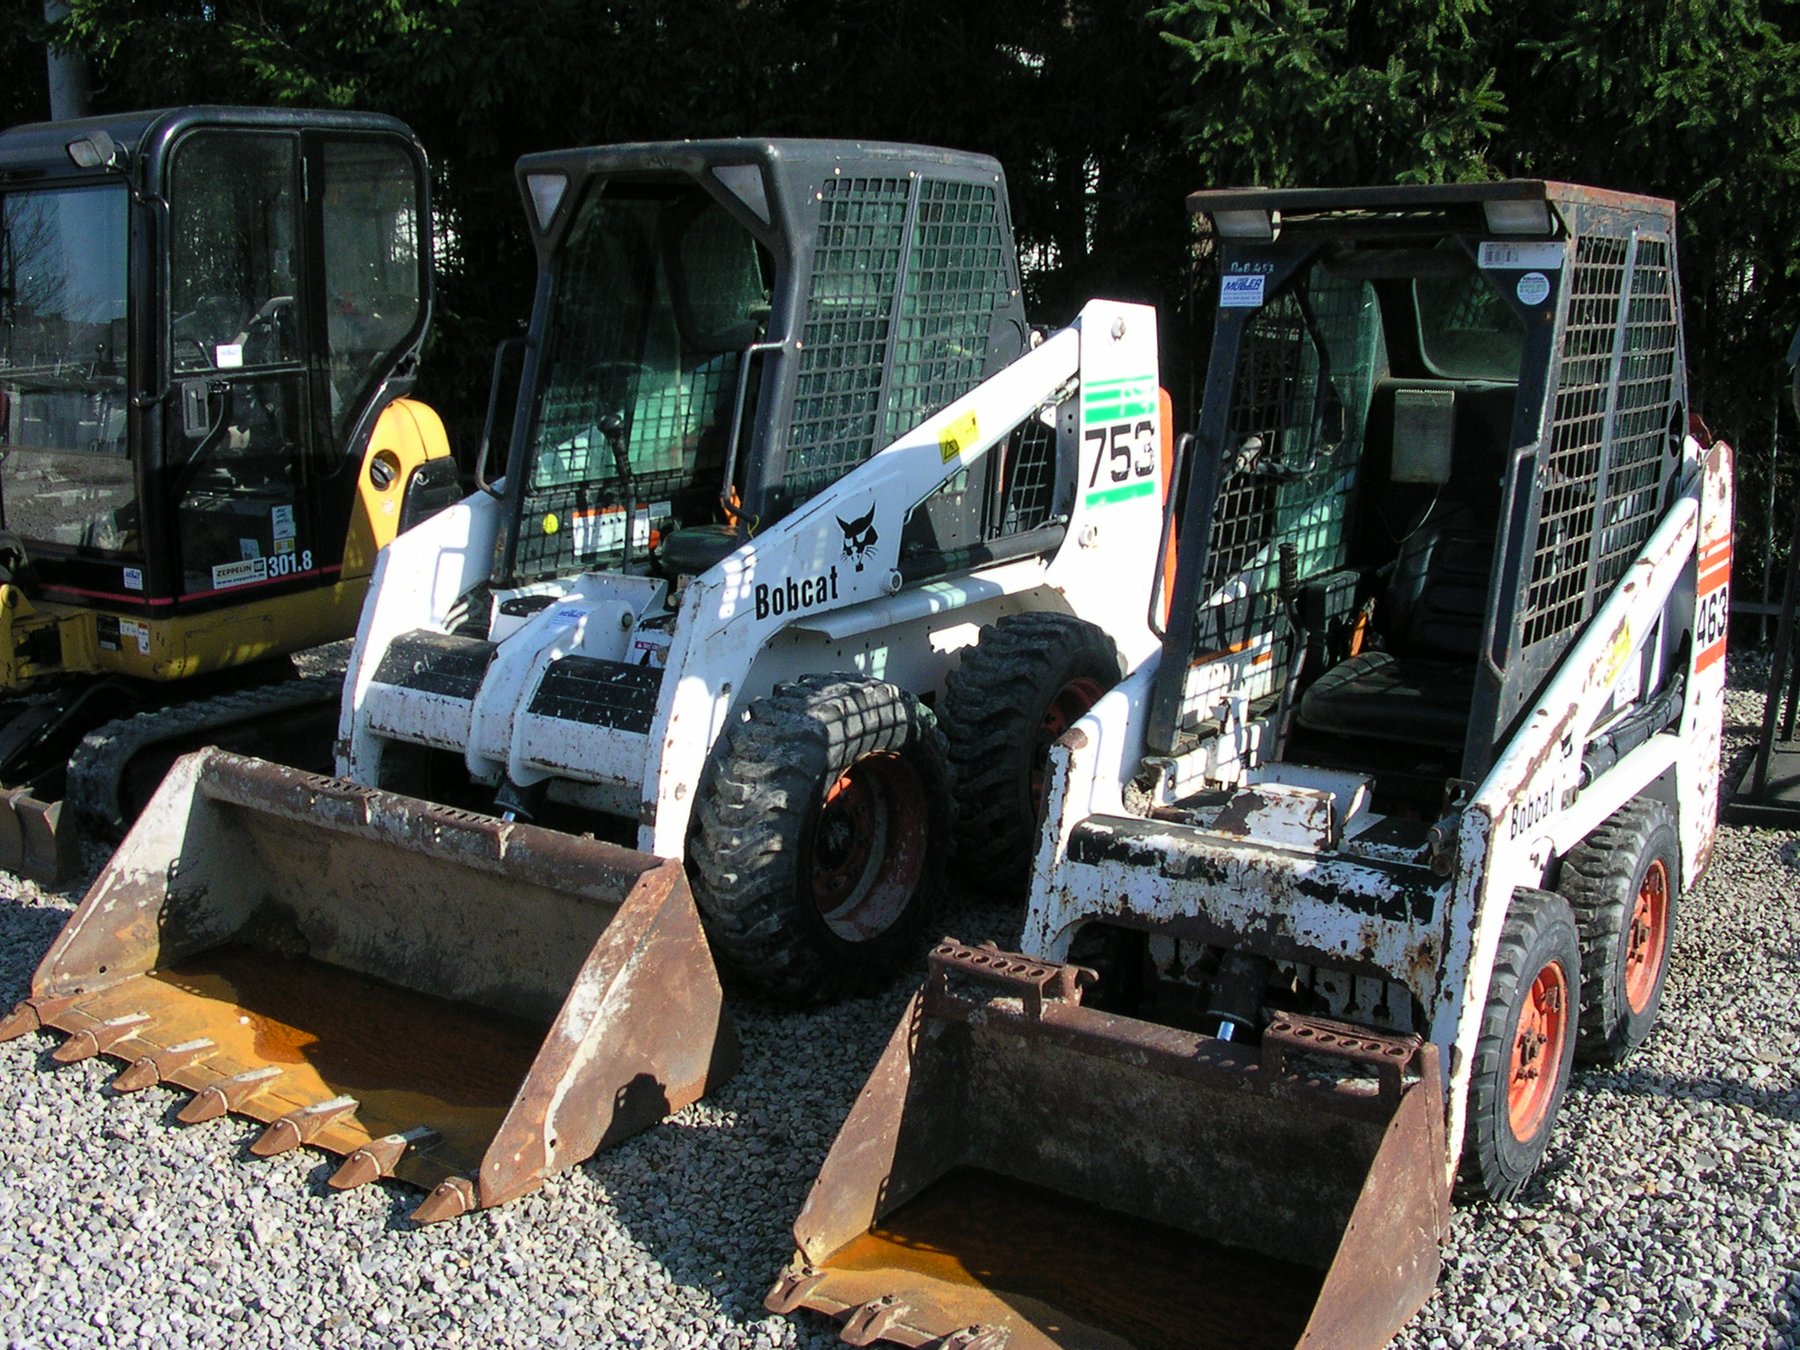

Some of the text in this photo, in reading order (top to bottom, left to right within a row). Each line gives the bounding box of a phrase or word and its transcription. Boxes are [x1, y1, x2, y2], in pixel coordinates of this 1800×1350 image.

[1084, 420, 1155, 488] 753
[216, 564, 252, 578] ZEPPELIN
[268, 550, 313, 577] 301.8
[755, 565, 838, 621] Bobcat
[1697, 586, 1728, 648] 463
[1510, 779, 1555, 841] Bobcat
